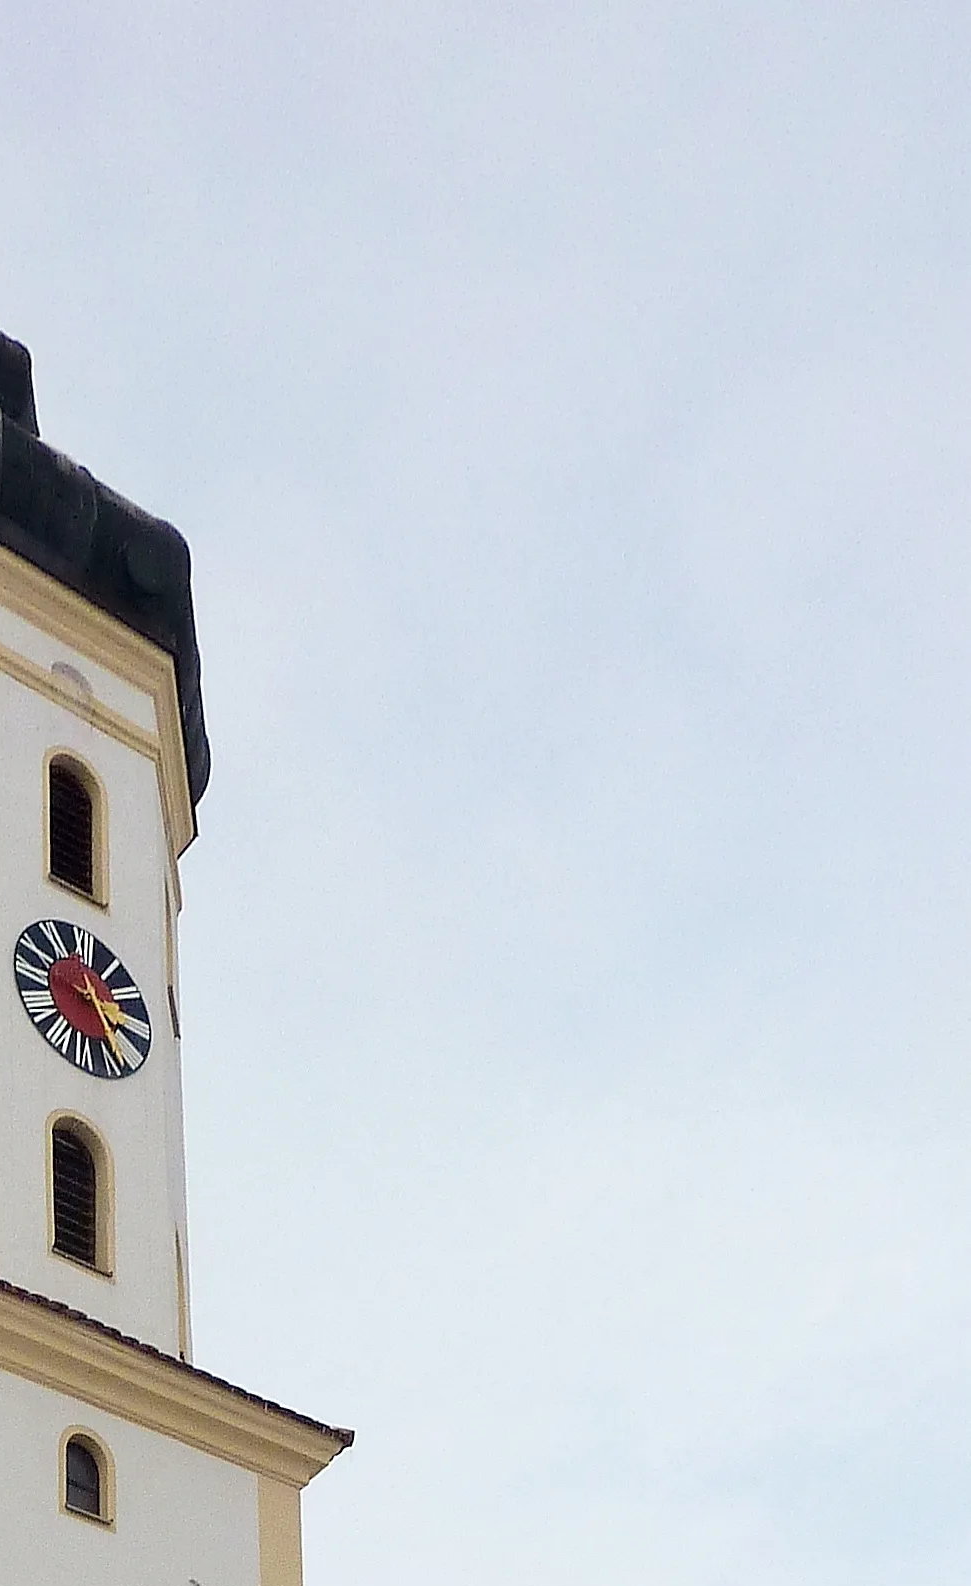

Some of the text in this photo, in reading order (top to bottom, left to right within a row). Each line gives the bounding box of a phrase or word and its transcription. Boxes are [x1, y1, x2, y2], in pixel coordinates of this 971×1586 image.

[20, 932, 55, 969] X
[39, 921, 69, 959] XI
[73, 926, 94, 968] XII
[16, 954, 48, 986] IX
[101, 958, 120, 980] I
[21, 990, 58, 1023] VIII
[111, 986, 140, 1000] II
[46, 1015, 72, 1054] VII
[76, 1031, 93, 1071] VI
[101, 1040, 121, 1077] V
